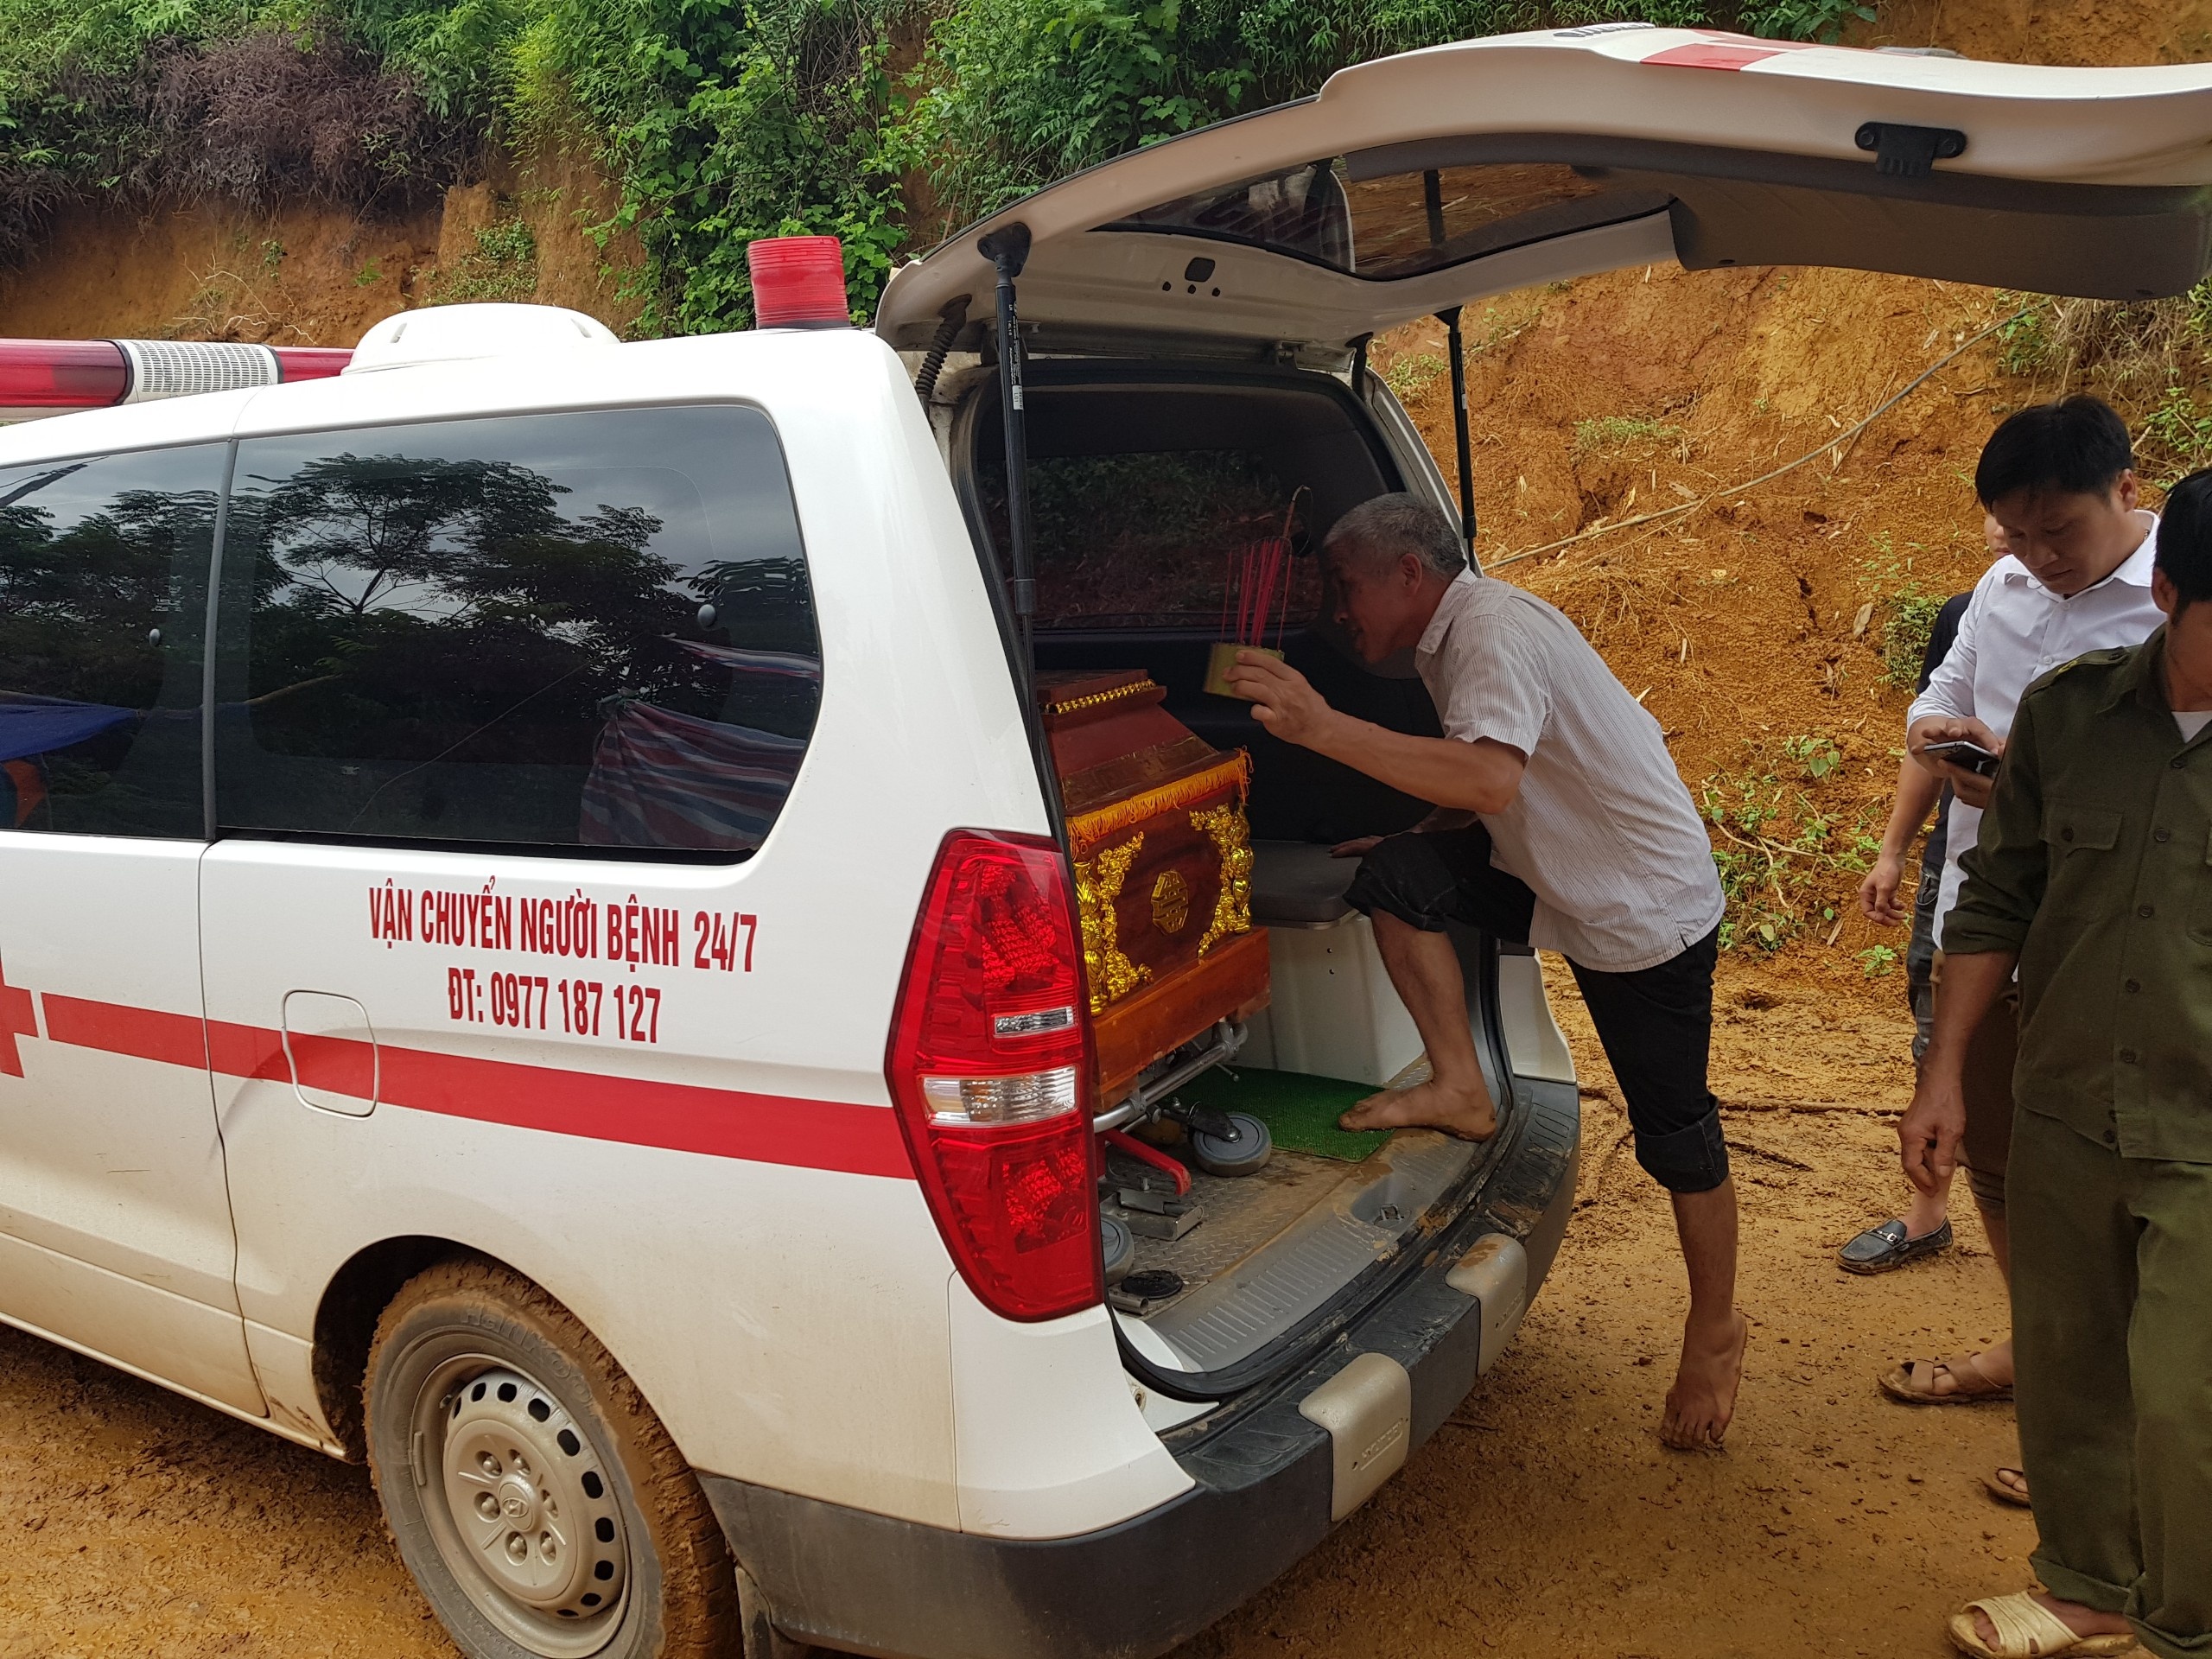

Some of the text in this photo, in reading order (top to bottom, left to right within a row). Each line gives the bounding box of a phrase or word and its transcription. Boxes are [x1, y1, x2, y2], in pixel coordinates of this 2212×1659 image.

[369, 875, 757, 973] VẬN CHUYỂN NGƯỜI BỆNH 24/7
[448, 967, 661, 1044] ĐT: 0977 187 127
